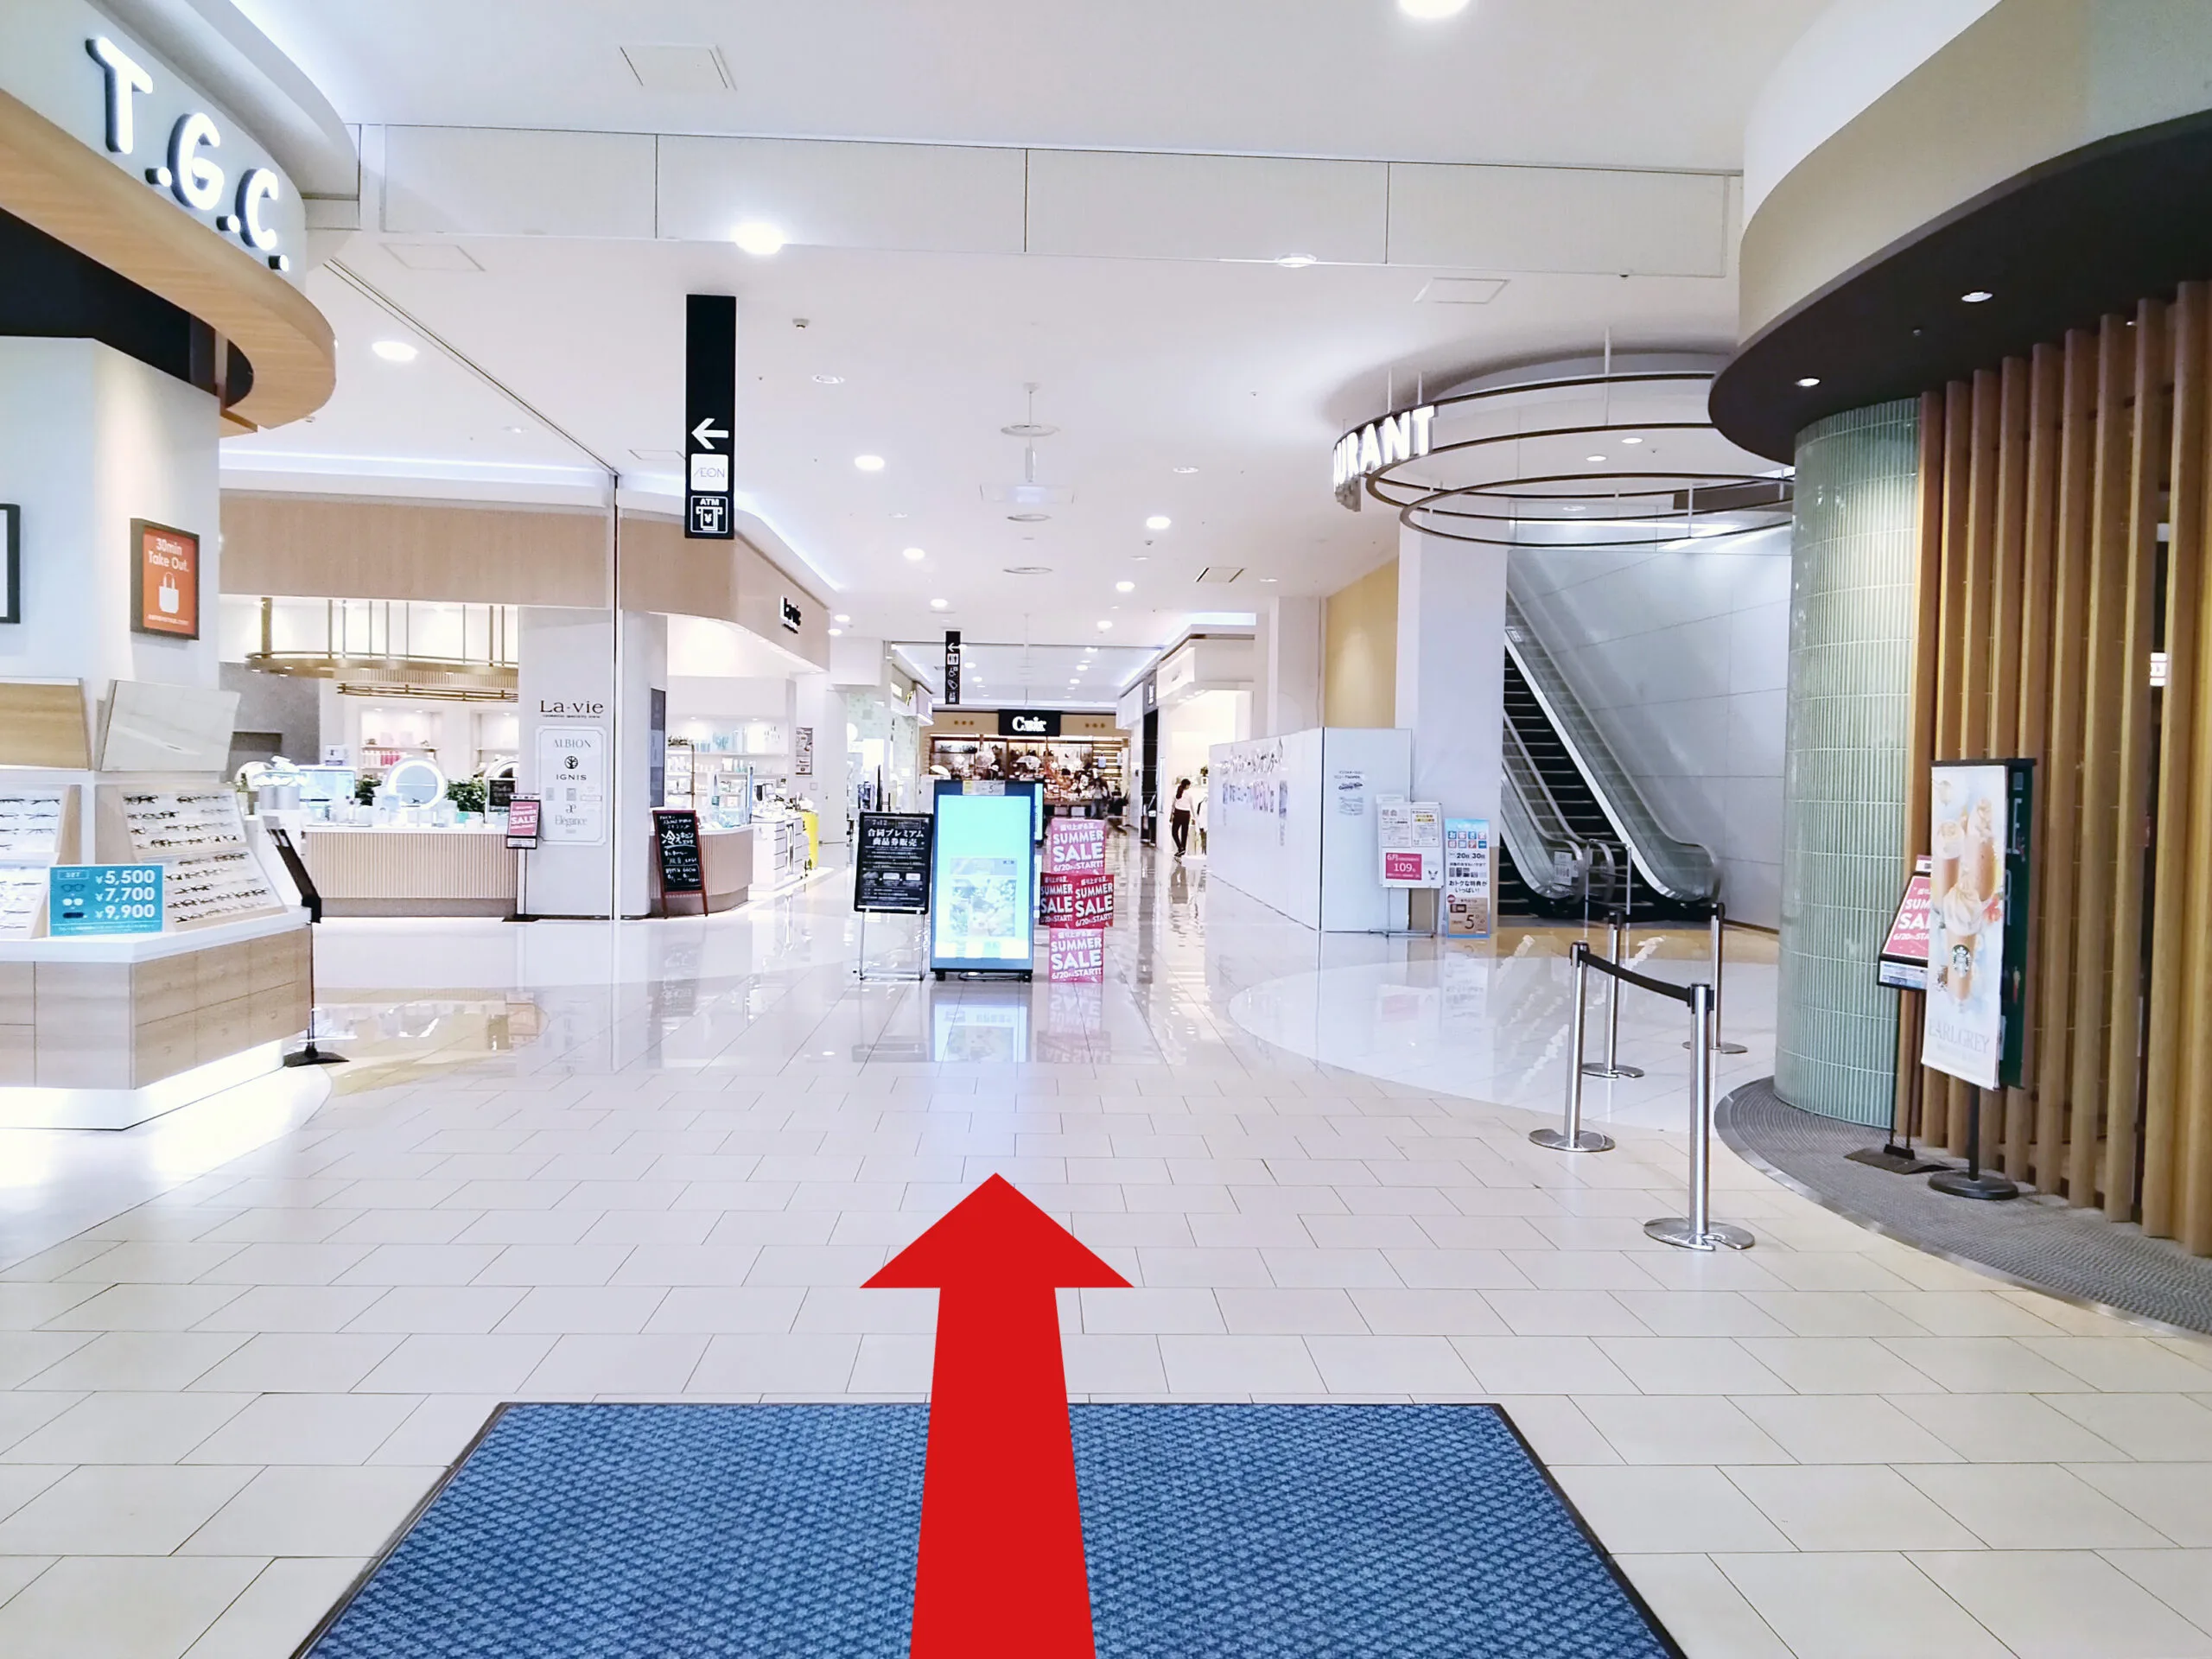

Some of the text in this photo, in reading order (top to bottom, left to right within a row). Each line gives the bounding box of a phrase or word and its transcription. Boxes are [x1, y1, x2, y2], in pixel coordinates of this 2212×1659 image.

[86, 36, 289, 272] T.G.C.
[1333, 405, 1439, 494] URANT
[156, 537, 182, 556] 30min
[149, 550, 170, 568] Take
[554, 739, 592, 748] ALBION
[511, 816, 536, 824] SALE
[868, 829, 925, 838] 合同プレミアム
[1052, 830, 1104, 845] SUMMER
[873, 837, 918, 847] 商品券販売
[1052, 842, 1104, 862] SALE
[95, 869, 156, 886] ¥5,500
[95, 887, 156, 902] ¥7,700
[1040, 884, 1073, 895] SUMMER
[1075, 883, 1113, 899] SUMMER
[95, 904, 156, 920] ¥9,900
[1040, 896, 1073, 914] SALE
[1075, 894, 1114, 918] SALE
[1051, 938, 1103, 952] SUMMER
[1051, 950, 1103, 970] SALE
